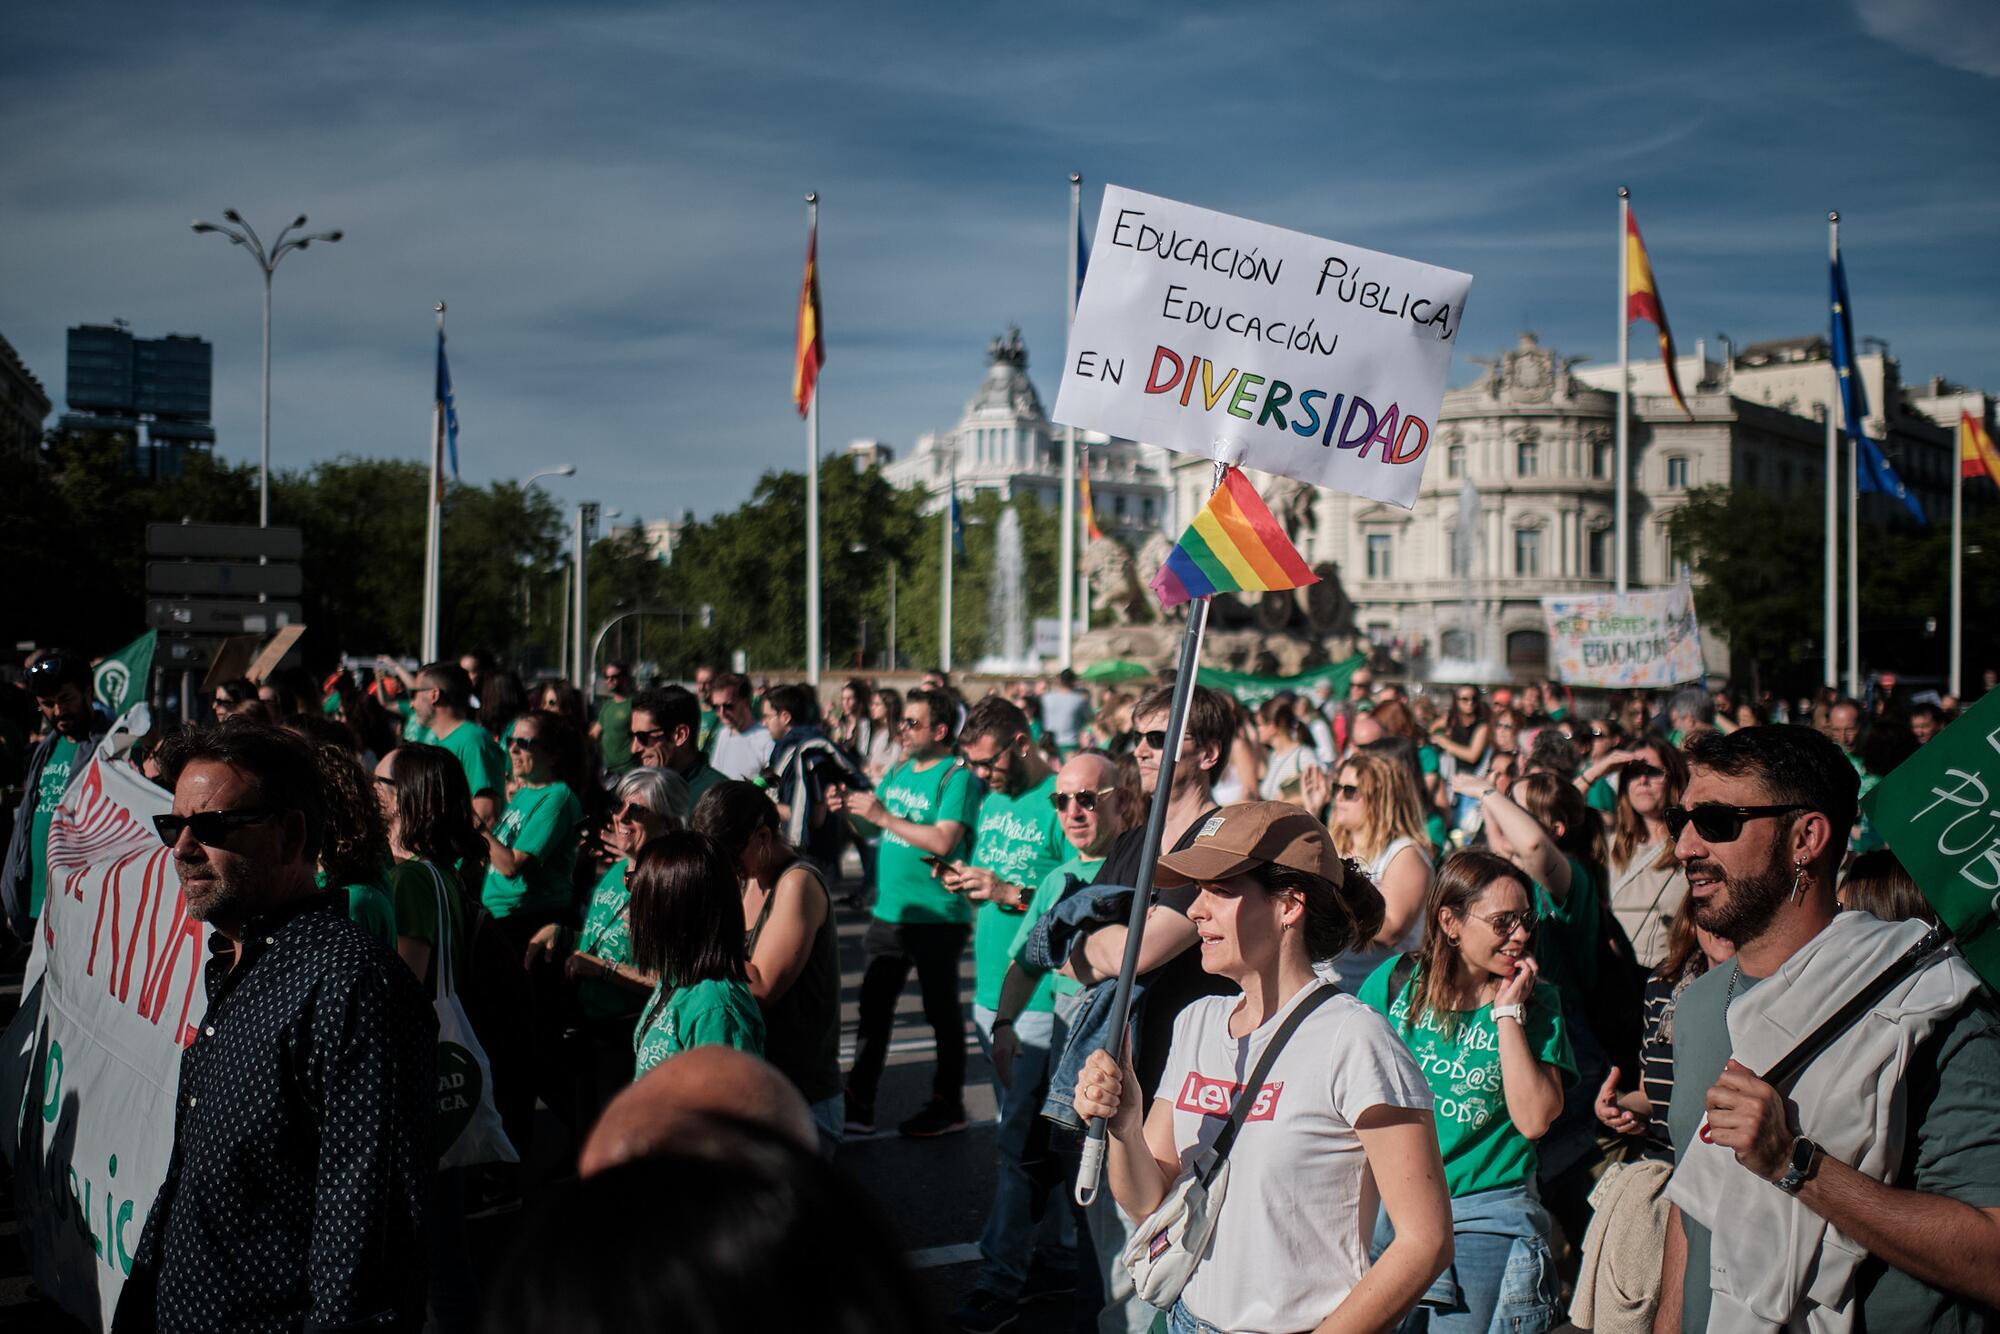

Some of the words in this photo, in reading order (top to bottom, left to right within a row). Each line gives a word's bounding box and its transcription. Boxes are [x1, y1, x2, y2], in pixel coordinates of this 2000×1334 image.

[1112, 208, 1283, 286] EDUCACIÓN
[1315, 256, 1453, 340] PÚBLICA,
[1162, 284, 1339, 356] EDUCACIÓN
[1075, 351, 1125, 385] EN
[1143, 344, 1430, 466] DIVERSIDAD
[437, 1072, 465, 1092] AD
[1419, 1053, 1502, 1093] TOD@S
[438, 1094, 469, 1112] CA
[1435, 1093, 1492, 1131] OD@
